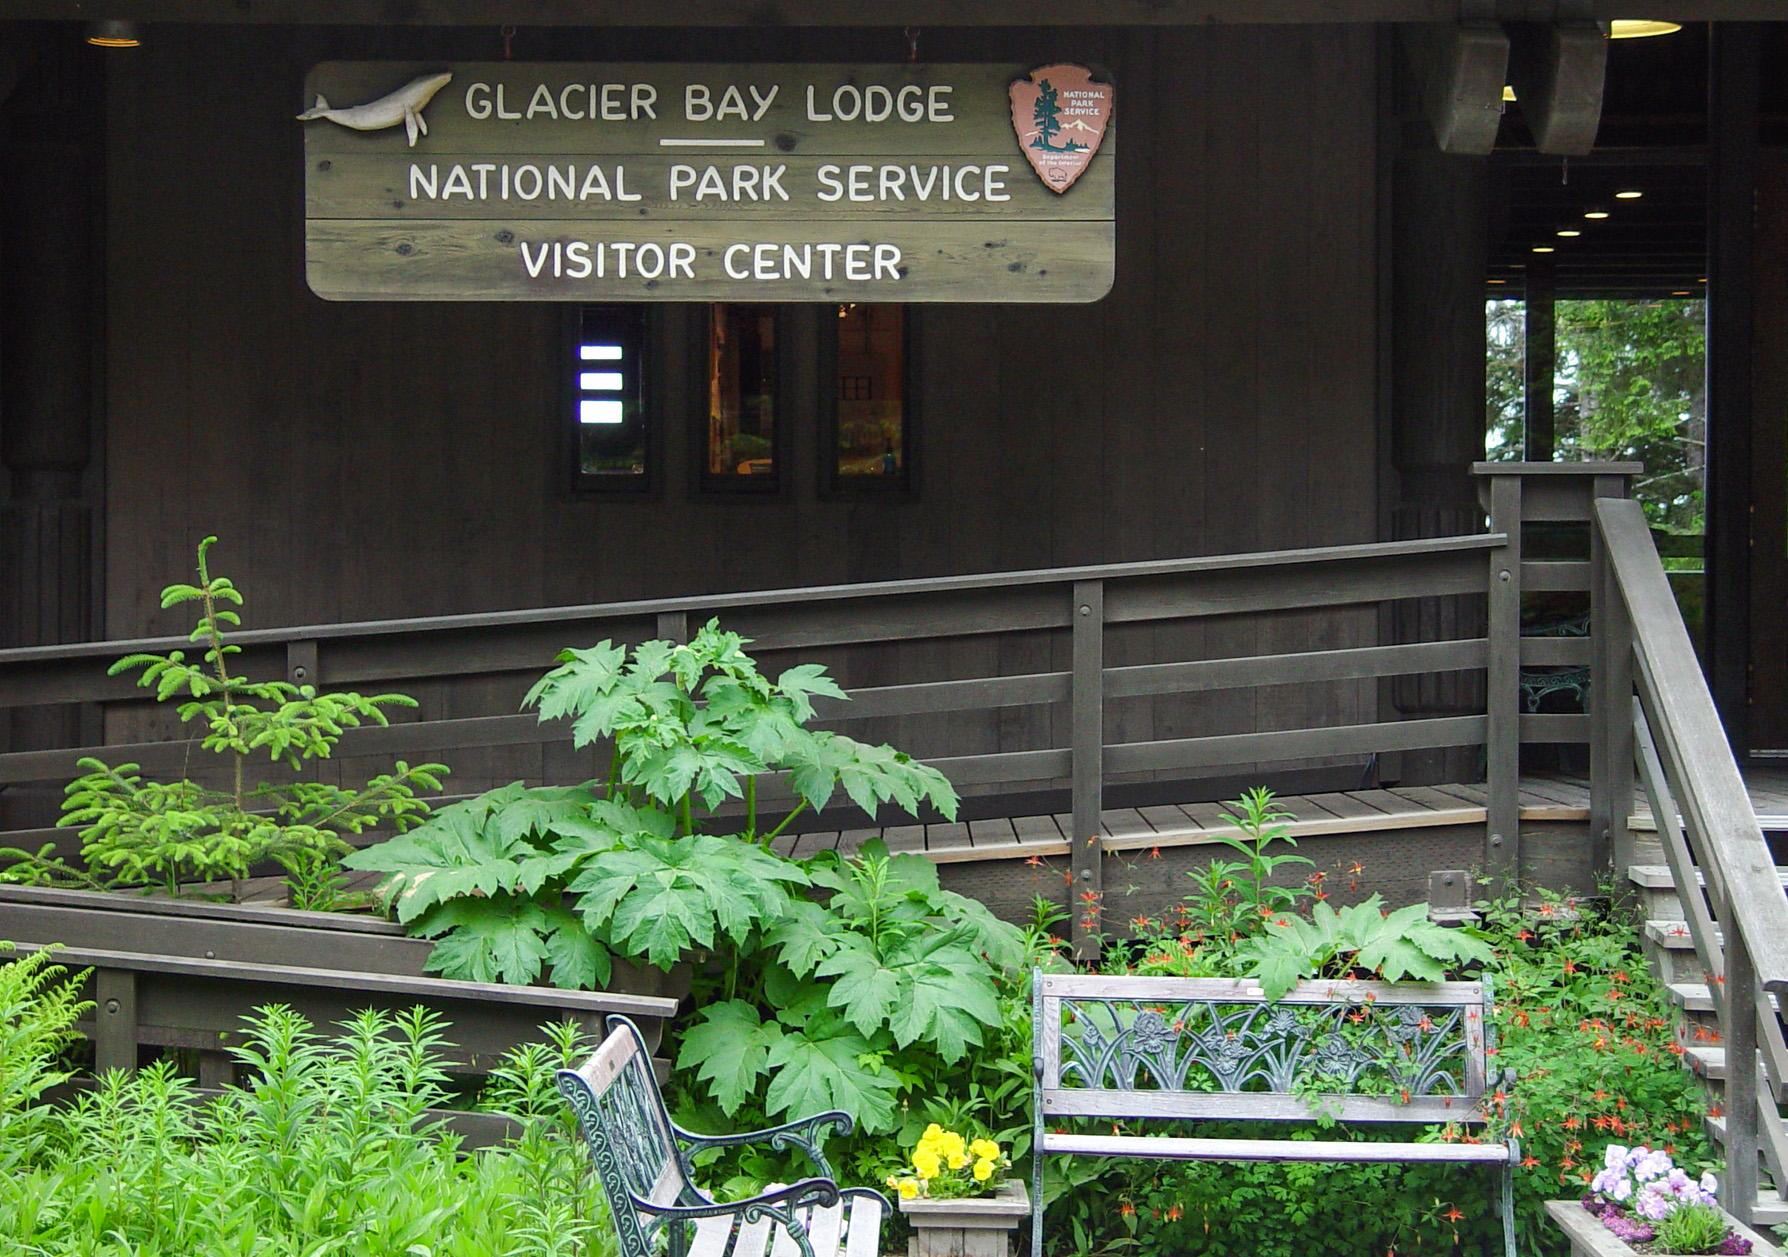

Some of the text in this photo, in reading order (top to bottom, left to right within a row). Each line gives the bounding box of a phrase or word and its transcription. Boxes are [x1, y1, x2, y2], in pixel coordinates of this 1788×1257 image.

[465, 82, 955, 123] GLACIER BAY LODGE
[1063, 91, 1105, 99] NATIONAL
[1071, 99, 1094, 107] PARK
[1064, 107, 1100, 116] SERVICE
[409, 163, 1011, 202] NATIONAL PARK SERVICE
[520, 241, 901, 281] VISITOR CENTER
